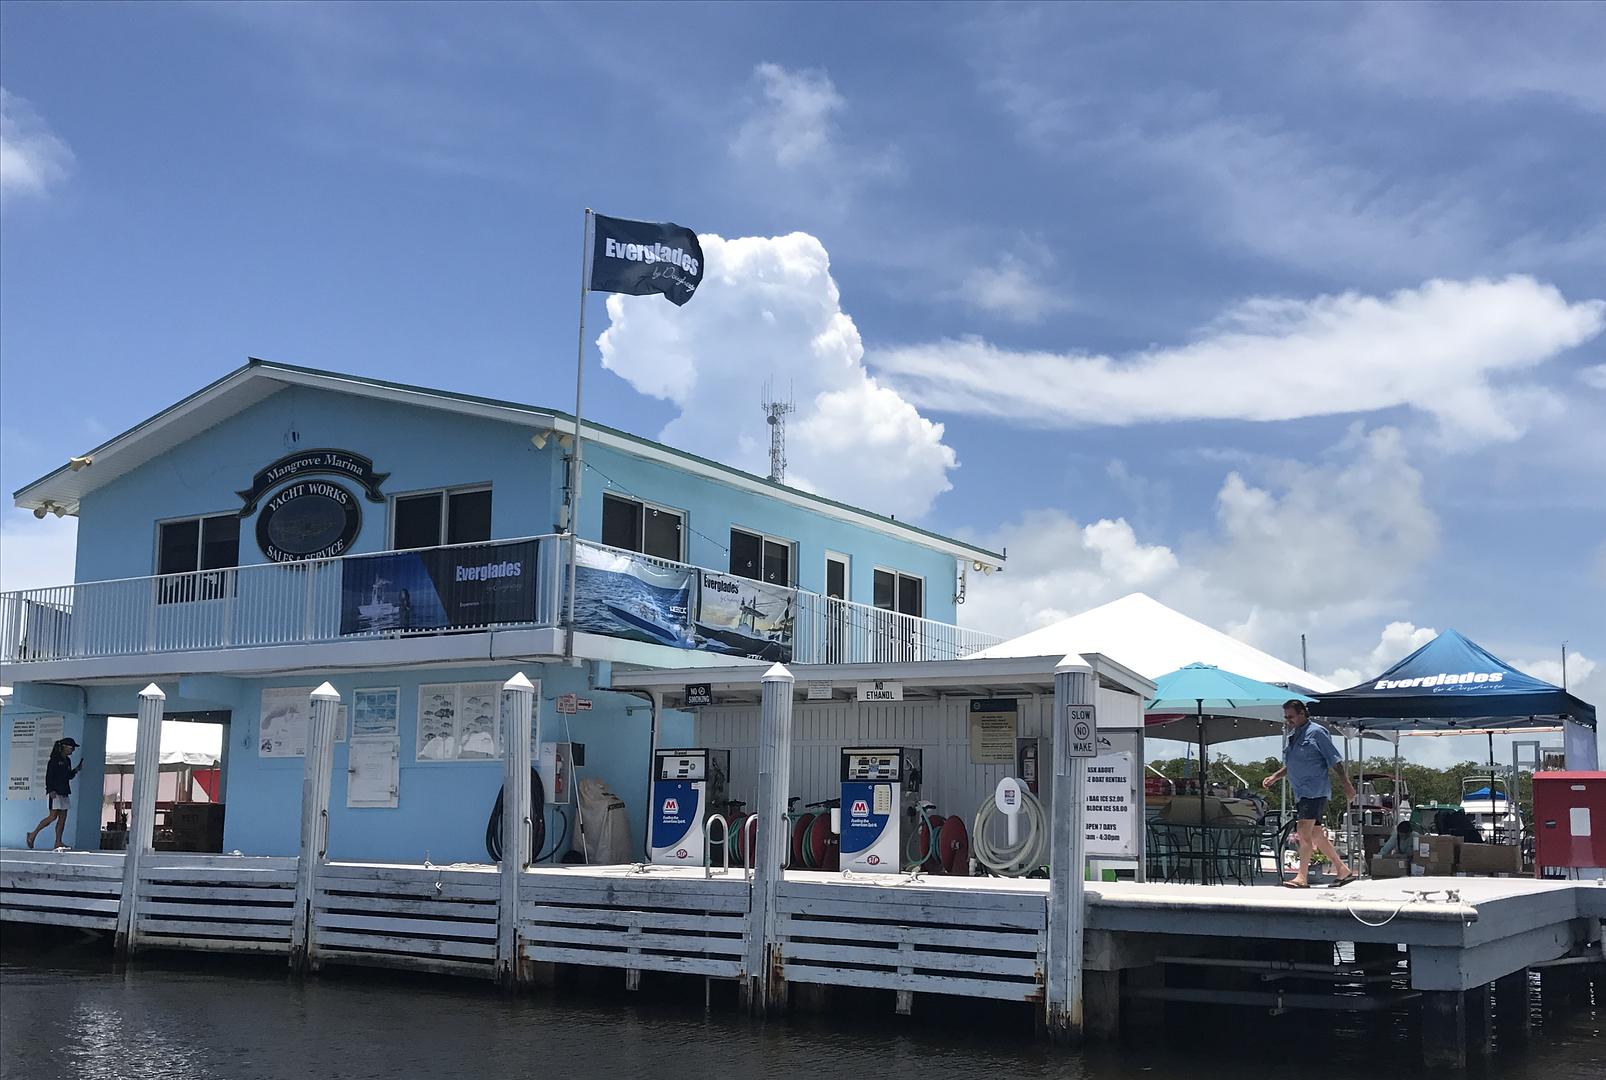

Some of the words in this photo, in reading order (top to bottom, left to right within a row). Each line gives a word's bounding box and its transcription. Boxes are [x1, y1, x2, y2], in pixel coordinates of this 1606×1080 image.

[605, 237, 699, 277] Everglades
[267, 457, 321, 483] Mangrove
[323, 454, 364, 476] Marina
[268, 484, 305, 512] YACHT
[308, 483, 349, 505] WORKS
[456, 561, 521, 582] Everglades
[703, 573, 739, 595] Everglades
[875, 681, 884, 690] NO
[1374, 671, 1503, 690] Everglades
[690, 687, 697, 695] NO
[866, 691, 895, 700] ETHANOL
[689, 695, 710, 704] SMOKING
[1071, 710, 1091, 720] SLOW
[1076, 726, 1087, 736] NO
[1073, 742, 1092, 752] WAKE
[1099, 833, 1120, 842] 4:30pm
[677, 850, 686, 858] STP
[868, 856, 879, 864] STP
